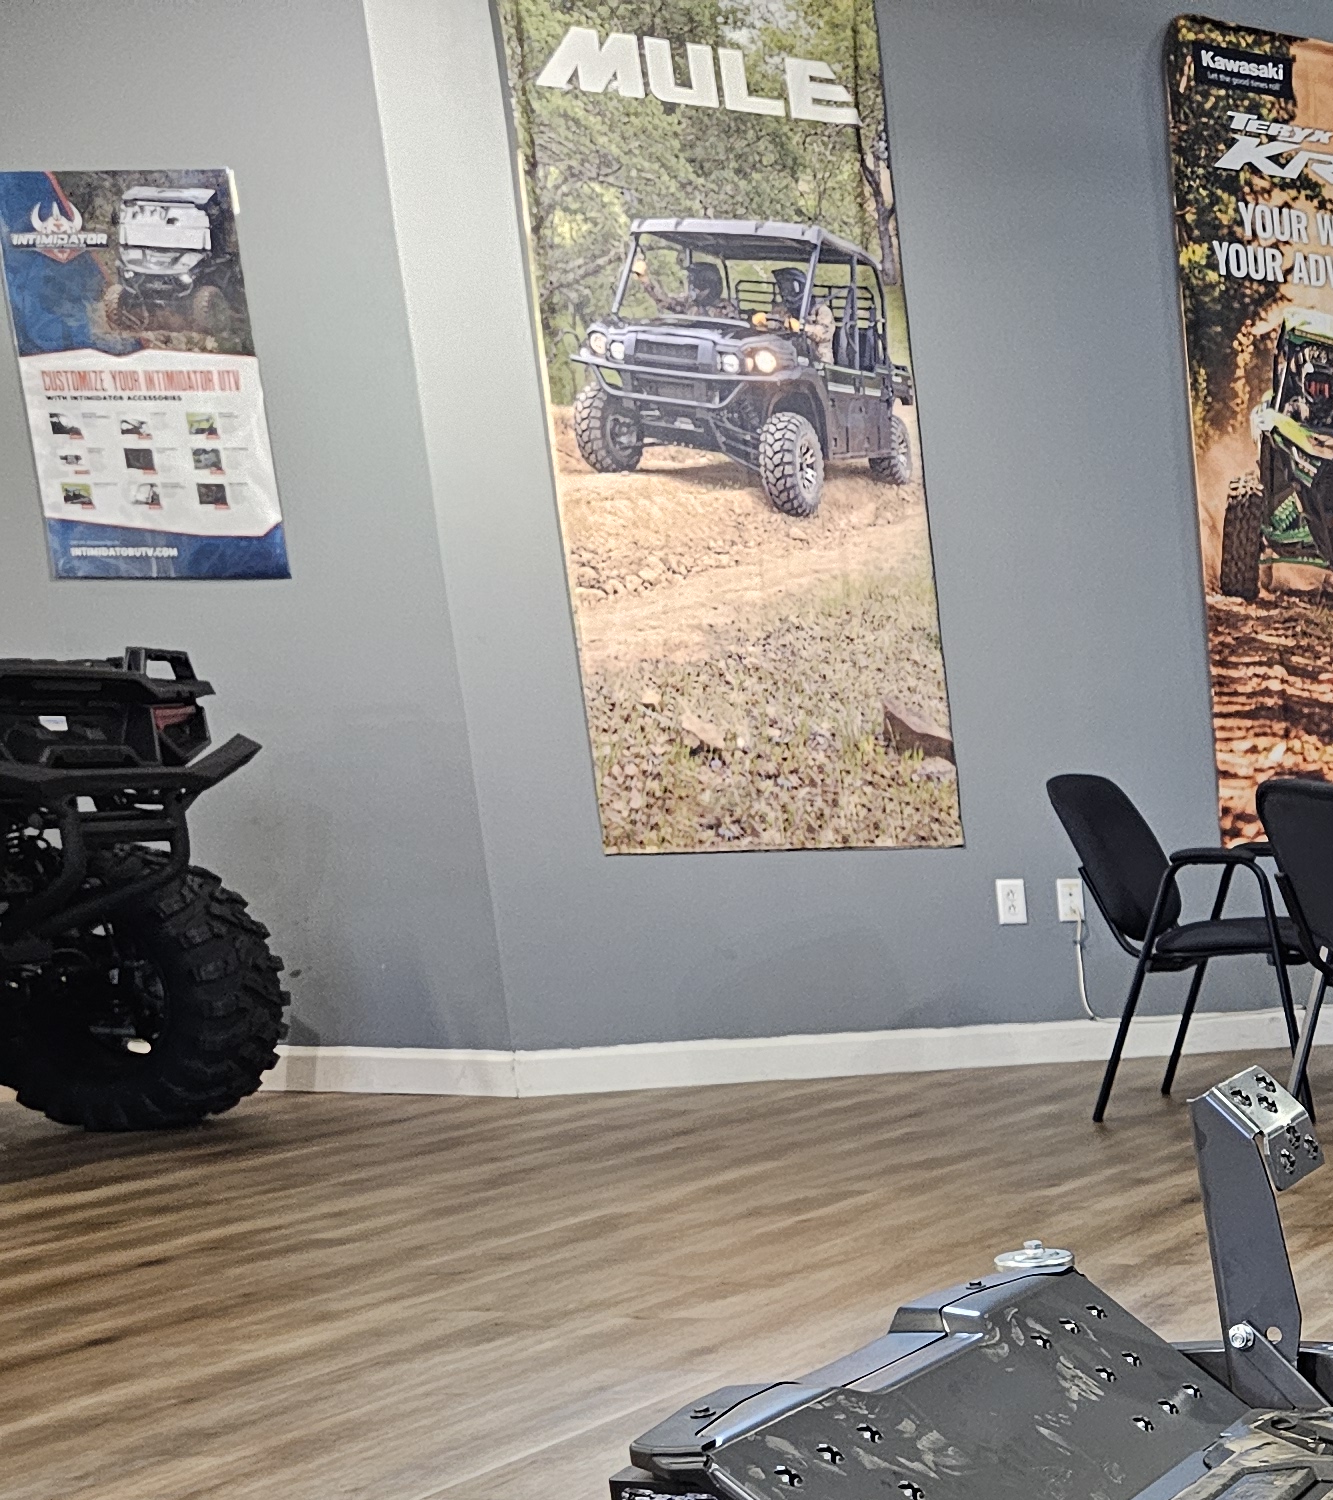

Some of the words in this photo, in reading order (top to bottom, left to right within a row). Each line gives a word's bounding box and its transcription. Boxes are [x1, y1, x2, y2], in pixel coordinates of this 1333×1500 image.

[536, 26, 863, 126] MULE
[1200, 49, 1284, 81] Kawasaki
[10, 232, 108, 246] INTIMIDATOR
[1237, 200, 1309, 244] YOUR
[1212, 239, 1285, 283] YOUR
[41, 369, 108, 392] CUSTOMIZE
[109, 369, 140, 392] YOUR
[144, 370, 216, 392] INTIMIDATOR
[217, 370, 241, 393] UTV
